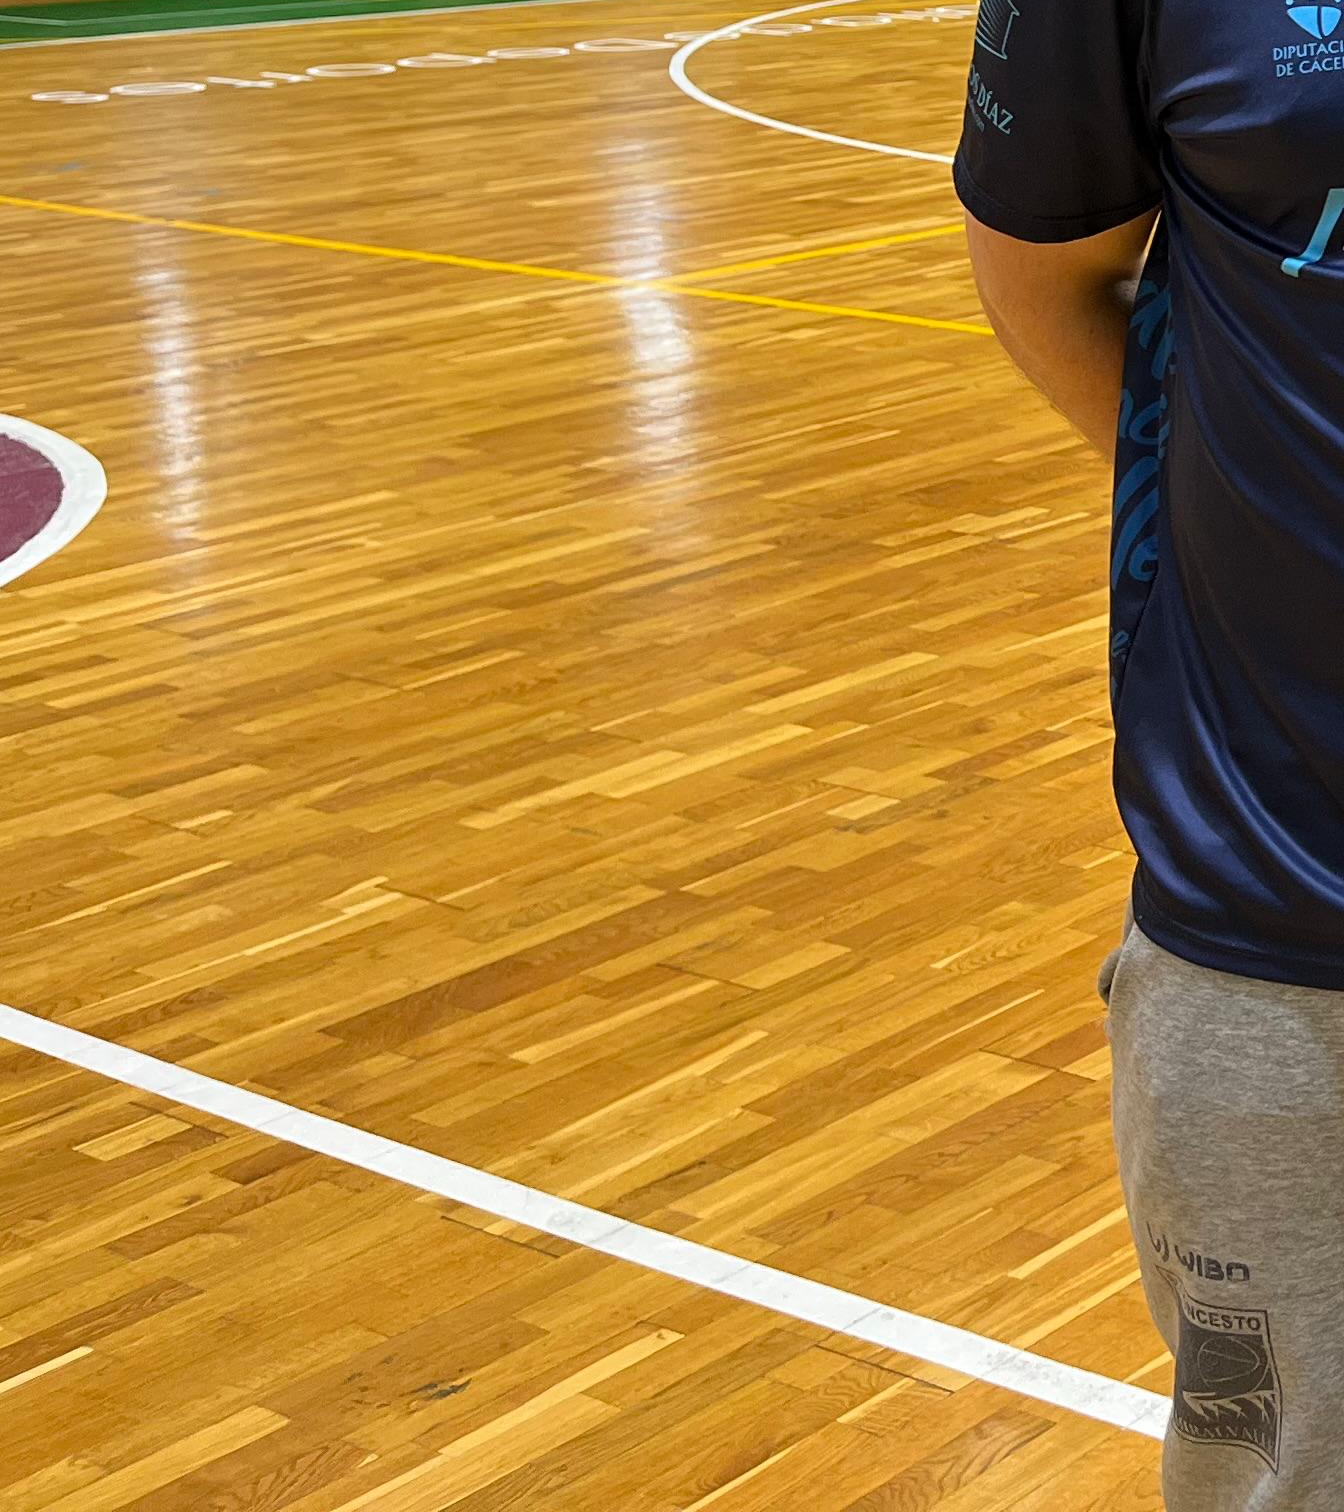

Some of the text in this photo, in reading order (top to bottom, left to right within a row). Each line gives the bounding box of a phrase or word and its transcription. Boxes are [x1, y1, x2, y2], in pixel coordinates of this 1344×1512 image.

[1275, 60, 1295, 78] DE
[976, 82, 1014, 135] DÍAZ
[1174, 1243, 1250, 1282] WIBO
[1186, 1305, 1262, 1332] NCESTO
